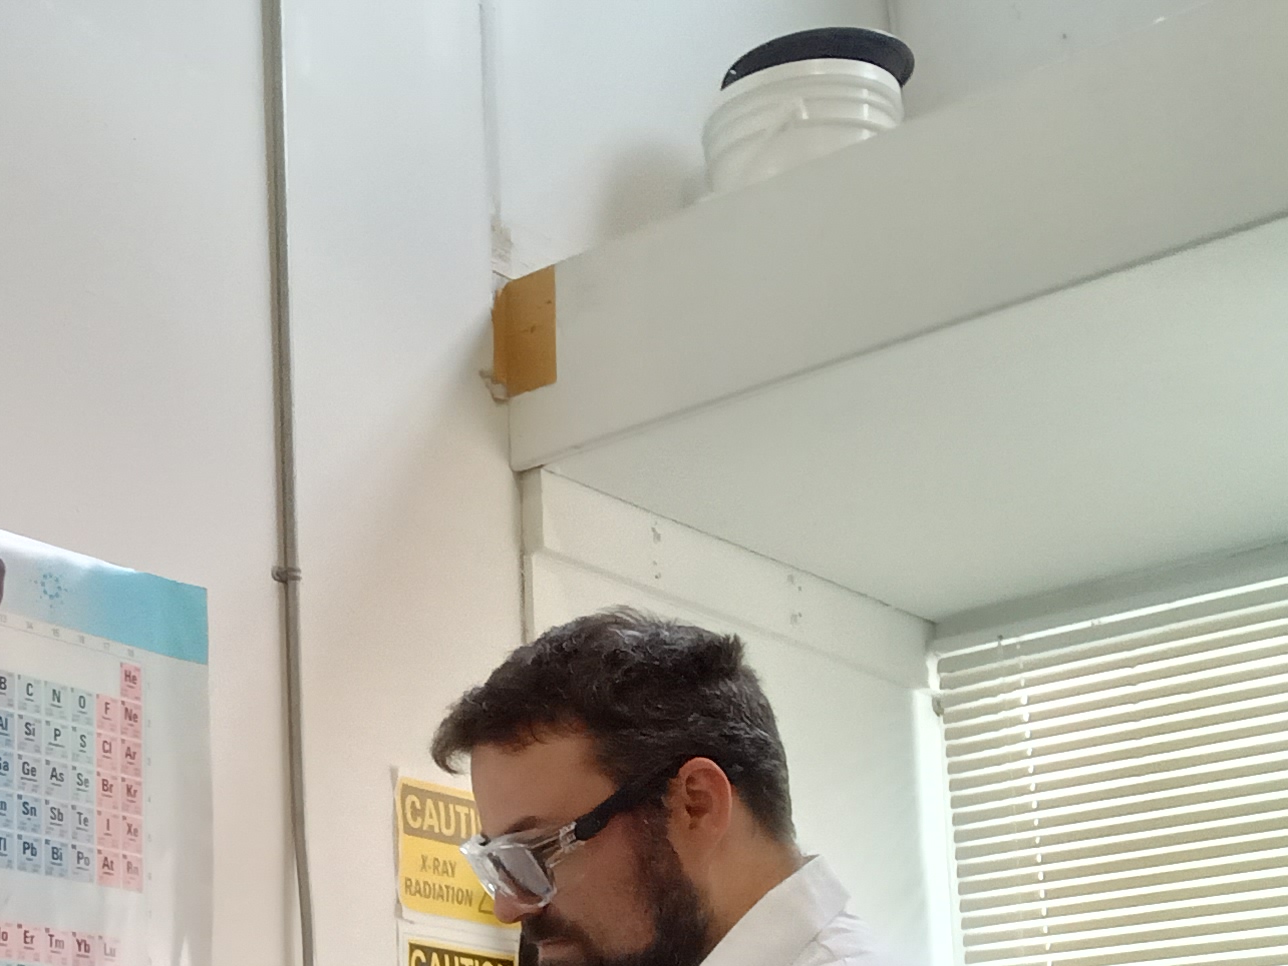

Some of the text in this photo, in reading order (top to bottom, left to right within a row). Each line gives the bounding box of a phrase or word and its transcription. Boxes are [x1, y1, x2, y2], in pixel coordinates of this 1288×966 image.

[124, 669, 138, 685] He
[26, 682, 34, 697] C
[52, 688, 61, 704] N
[78, 694, 86, 709] O
[104, 701, 110, 715] F
[124, 706, 138, 723] Ne
[24, 721, 36, 737] Si
[53, 728, 61, 742] P
[79, 734, 87, 749] S
[125, 746, 137, 760] Ar
[21, 761, 37, 777] Ge
[49, 766, 64, 782] As
[76, 772, 90, 788] Se
[101, 778, 113, 794] Br
[126, 783, 138, 799] Kr
[22, 801, 37, 817] Sn
[49, 806, 64, 822] Sb
[76, 811, 89, 827] Te
[106, 818, 110, 831] I
[126, 822, 138, 838] Xe
[405, 794, 481, 839] CAUTI
[22, 841, 37, 857] Pb
[51, 846, 63, 862] Bi
[76, 850, 90, 867] Po
[420, 854, 456, 878] X-RAY
[404, 876, 473, 907] RADIATION
[23, 929, 35, 945] Er
[48, 933, 65, 949] Tm
[75, 938, 91, 954] Yb
